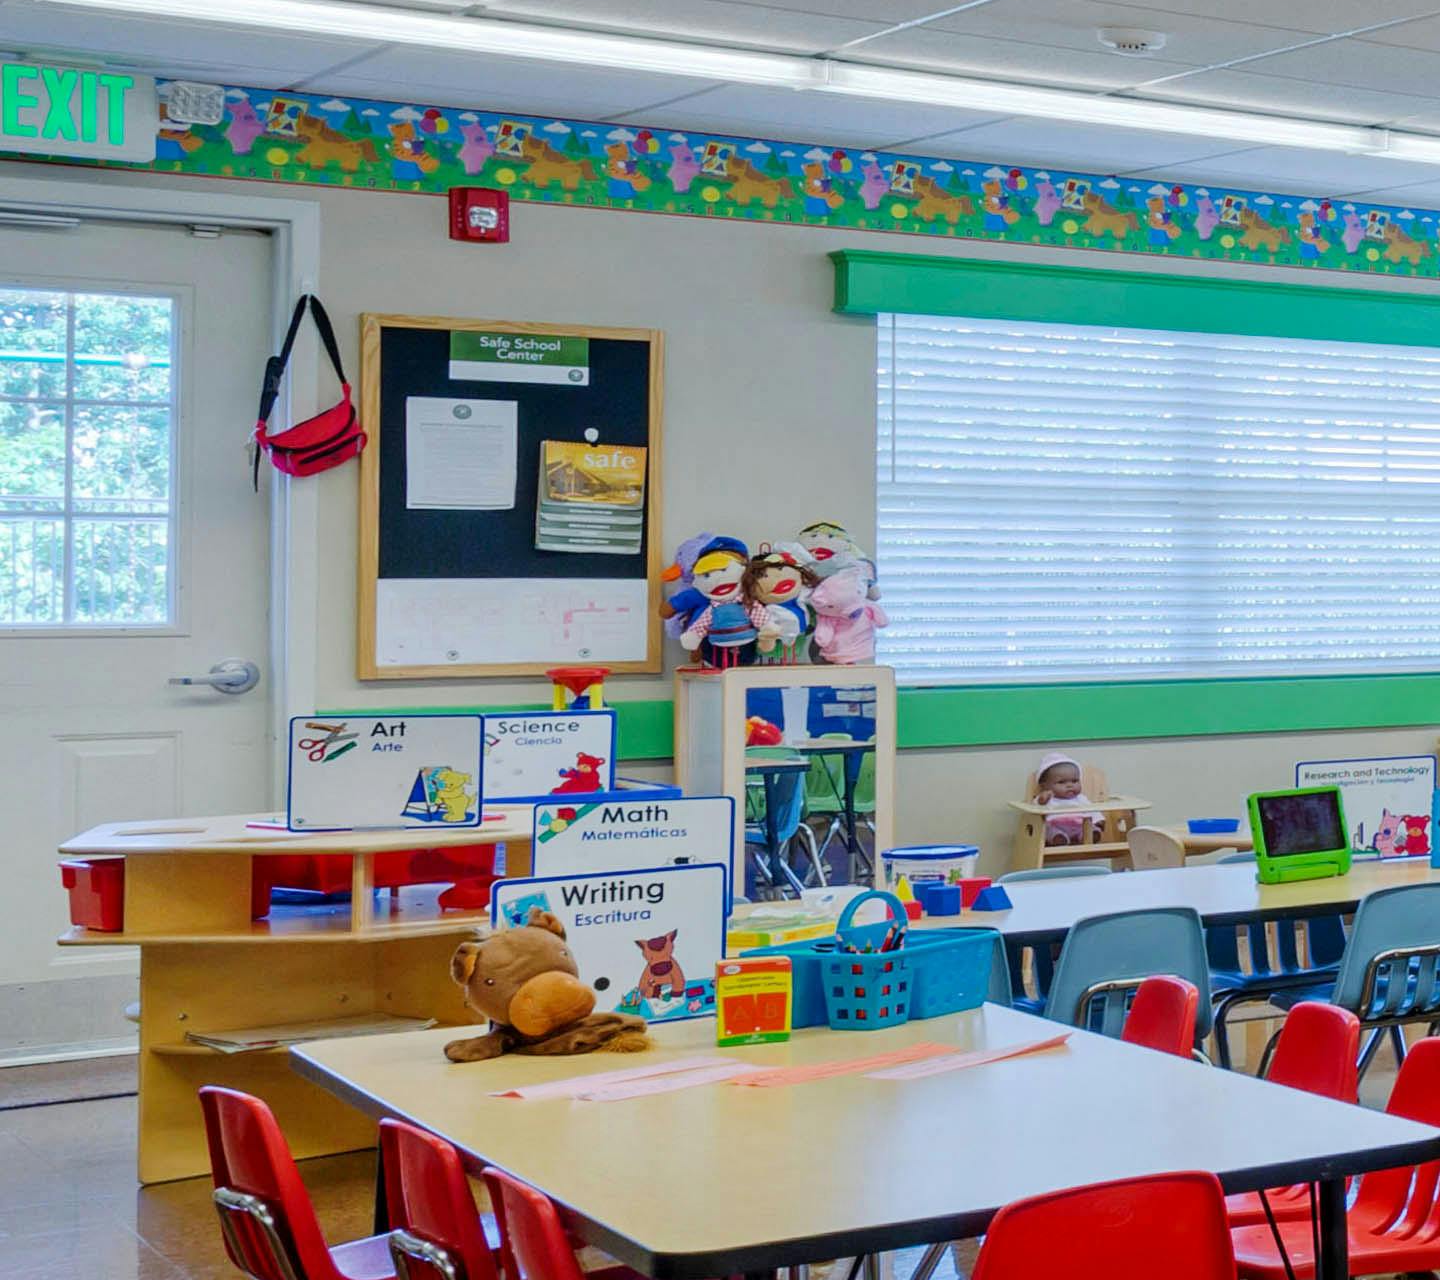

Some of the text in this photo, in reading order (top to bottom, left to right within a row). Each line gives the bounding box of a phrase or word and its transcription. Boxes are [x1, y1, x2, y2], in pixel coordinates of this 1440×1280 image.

[2, 64, 134, 146] EXIT
[480, 336, 561, 351] Safe School
[496, 349, 544, 361] Center
[584, 450, 636, 469] safe
[371, 721, 406, 737] Art
[498, 721, 579, 734] Science
[372, 742, 403, 752] Arte
[1304, 766, 1429, 780] Research and Technology
[601, 806, 668, 824] Math
[582, 827, 687, 840] Matemáticas
[562, 880, 664, 907] Writing
[575, 910, 651, 927] Escritura
